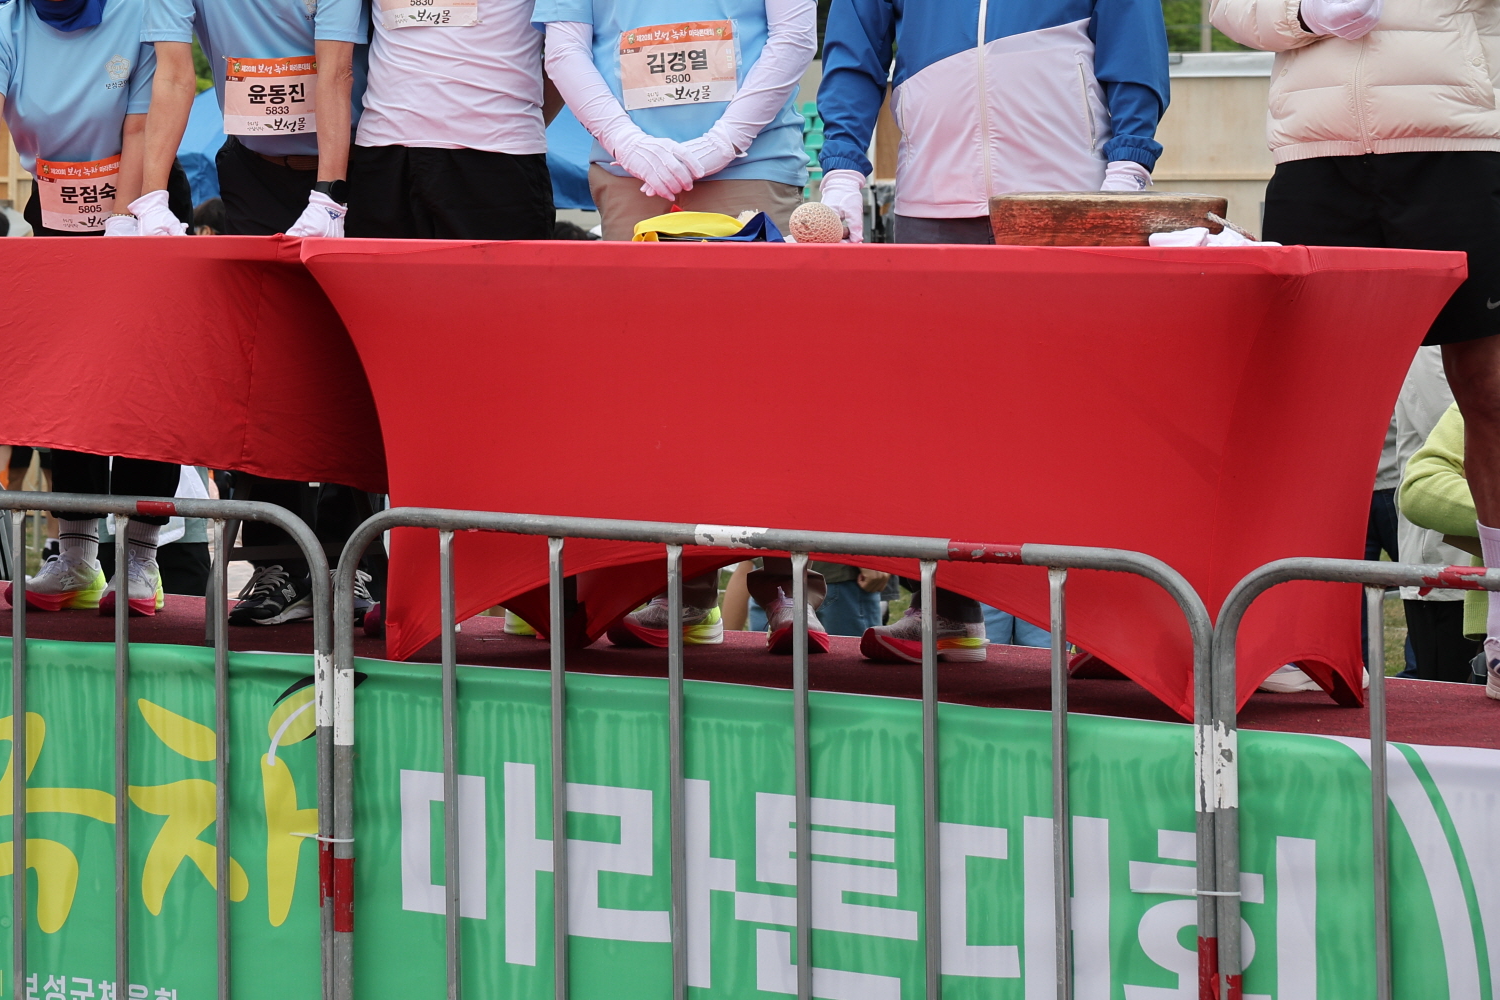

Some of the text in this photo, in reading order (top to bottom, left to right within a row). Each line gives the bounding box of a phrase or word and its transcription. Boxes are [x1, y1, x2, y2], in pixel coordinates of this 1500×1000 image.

[646, 49, 708, 74] 김경열
[665, 73, 691, 84] 5800
[247, 83, 306, 104] 윤동진
[265, 106, 290, 115] 5833
[60, 182, 117, 204] 문점숙
[78, 204, 102, 214] 5805
[400, 763, 1316, 1000] 마라톤대회
